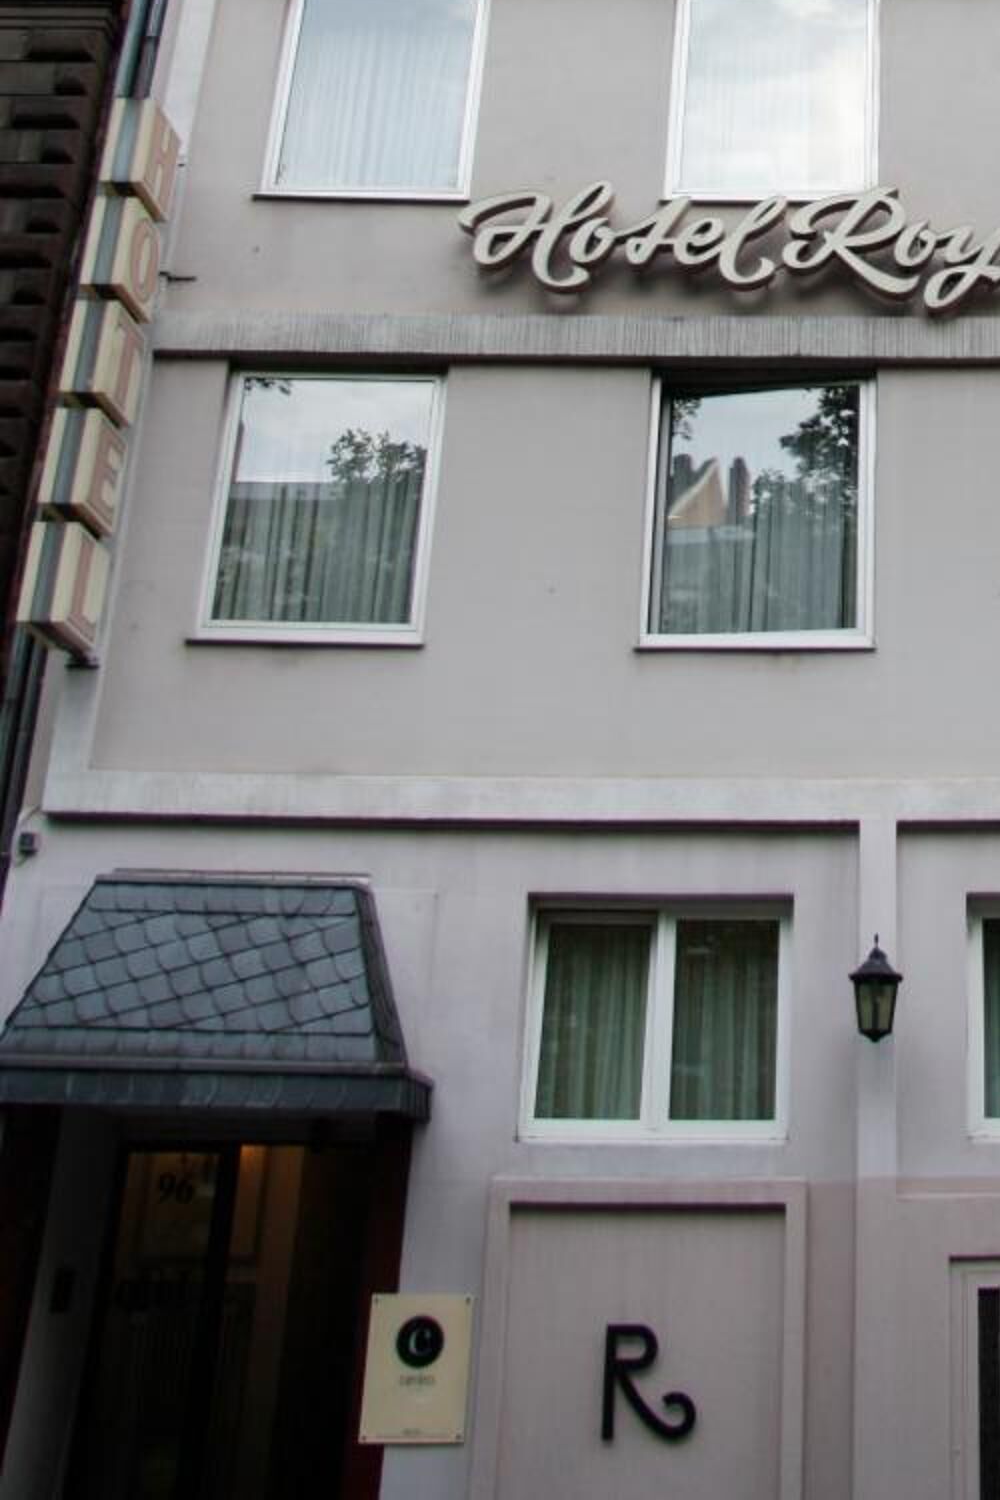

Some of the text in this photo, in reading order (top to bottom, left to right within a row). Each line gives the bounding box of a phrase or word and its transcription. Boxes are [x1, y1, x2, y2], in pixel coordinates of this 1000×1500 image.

[458, 181, 789, 294] Hotel
[67, 104, 181, 640] HOTEL
[156, 1171, 195, 1205] 96
[601, 1324, 697, 1442] R
